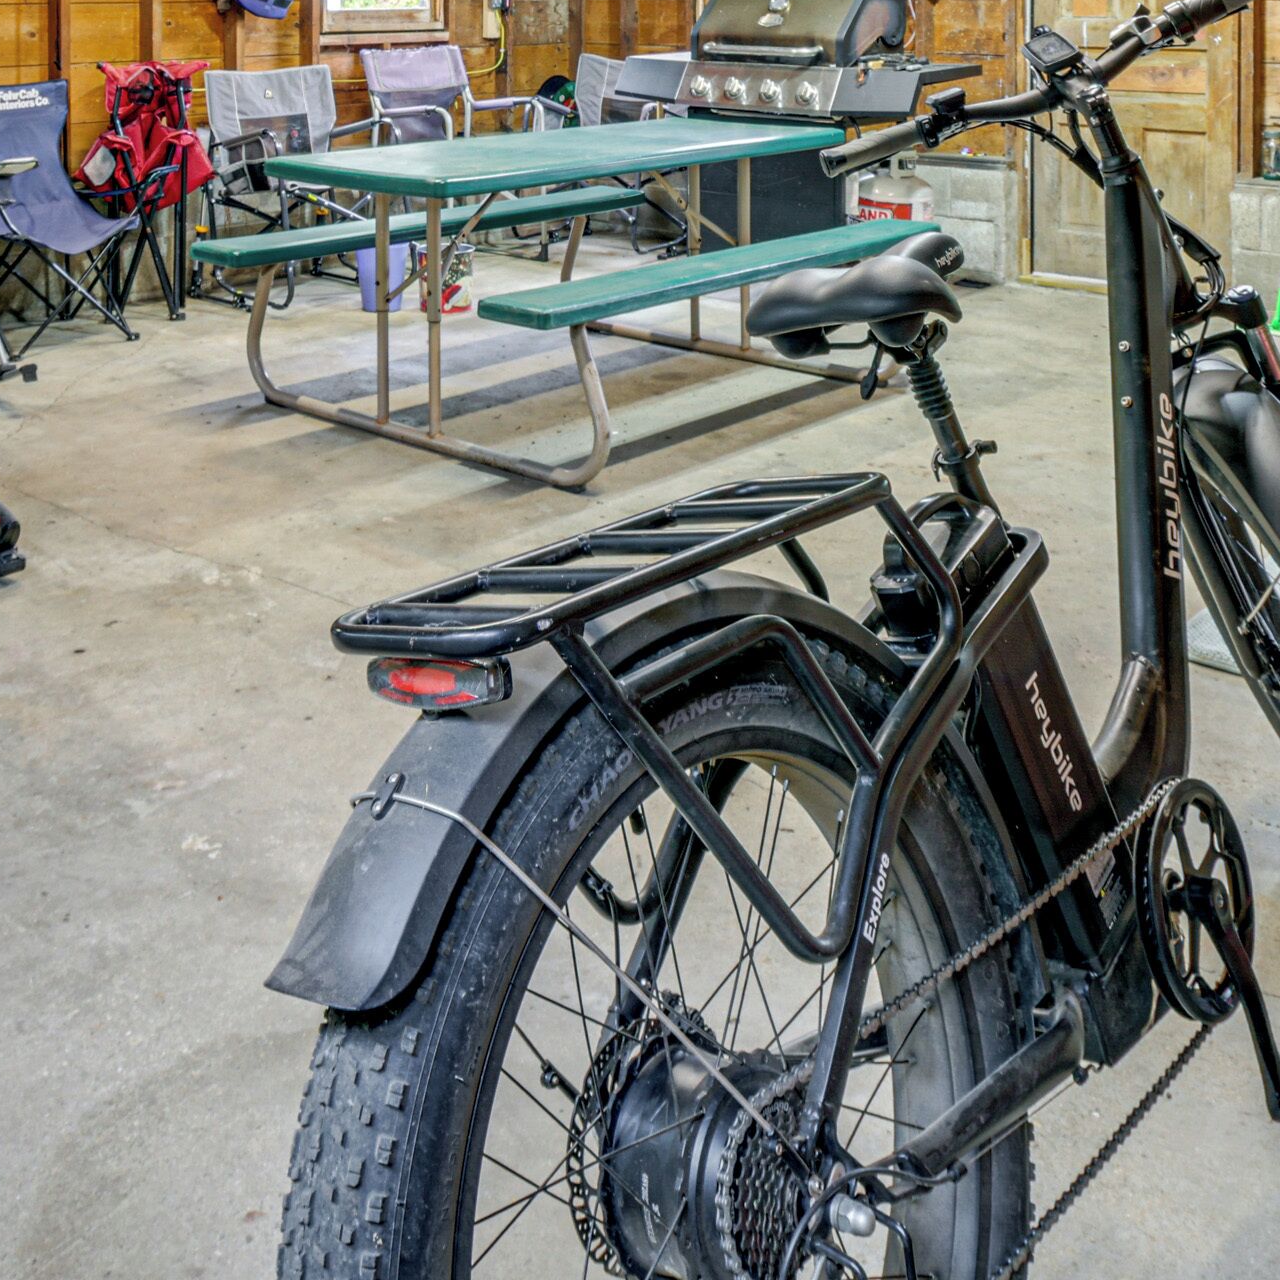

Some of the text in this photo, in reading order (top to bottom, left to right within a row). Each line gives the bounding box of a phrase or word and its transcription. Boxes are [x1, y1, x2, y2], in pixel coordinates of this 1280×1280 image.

[1156, 392, 1182, 580] heybike
[1025, 671, 1083, 812] heybike
[863, 852, 890, 945] Explore
